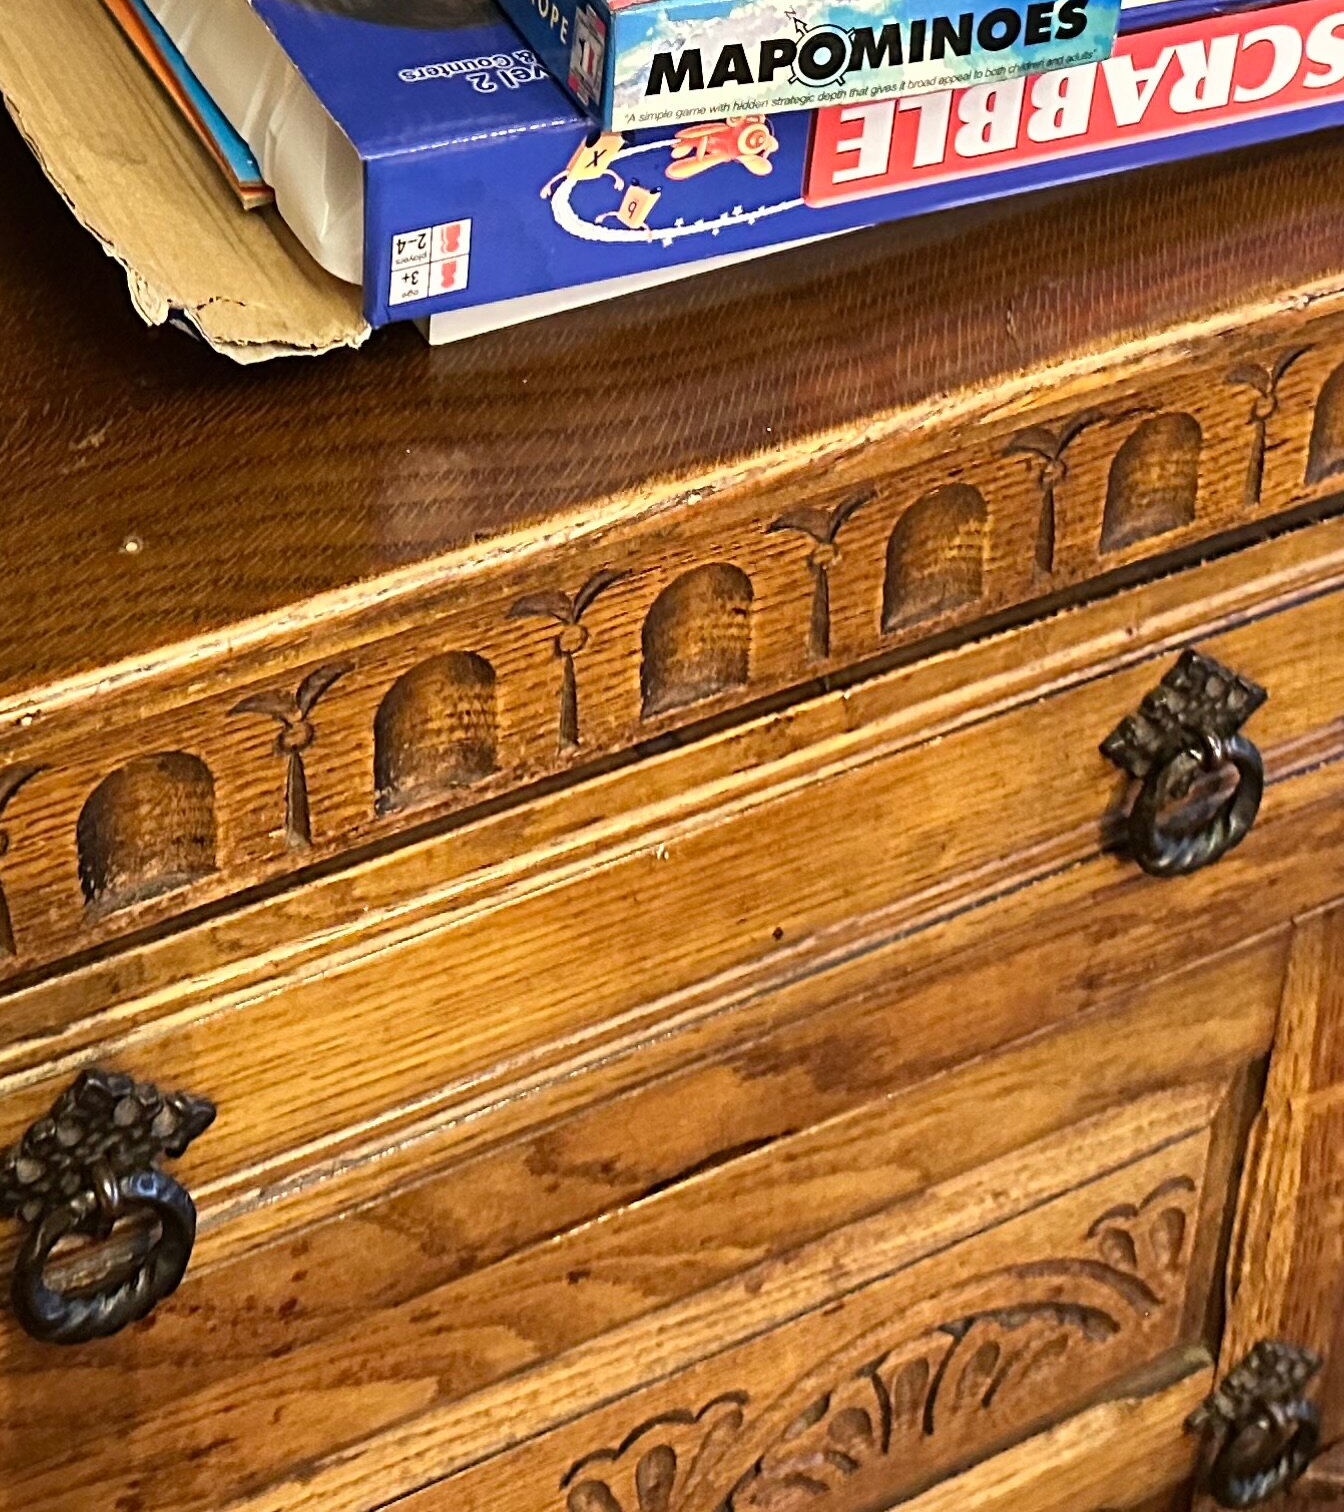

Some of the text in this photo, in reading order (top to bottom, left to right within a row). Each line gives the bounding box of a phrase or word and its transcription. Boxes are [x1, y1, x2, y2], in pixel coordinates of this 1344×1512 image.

[398, 54, 514, 83] Counters
[465, 61, 551, 94] vel 2
[638, 109, 673, 123] simple
[675, 107, 706, 120] game
[709, 103, 730, 114] with
[732, 98, 769, 112] hidden
[771, 92, 815, 107] strategic
[817, 89, 846, 103] depth
[848, 85, 869, 97] that
[870, 82, 897, 97] gives
[898, 80, 906, 91] it
[907, 76, 937, 90] broad
[938, 71, 972, 86] appeal
[972, 69, 983, 80] to
[984, 65, 1006, 78] both
[1008, 57, 1045, 75] children
[1046, 56, 1064, 68] and
[396, 252, 427, 265] players
[402, 270, 419, 286] 3+
